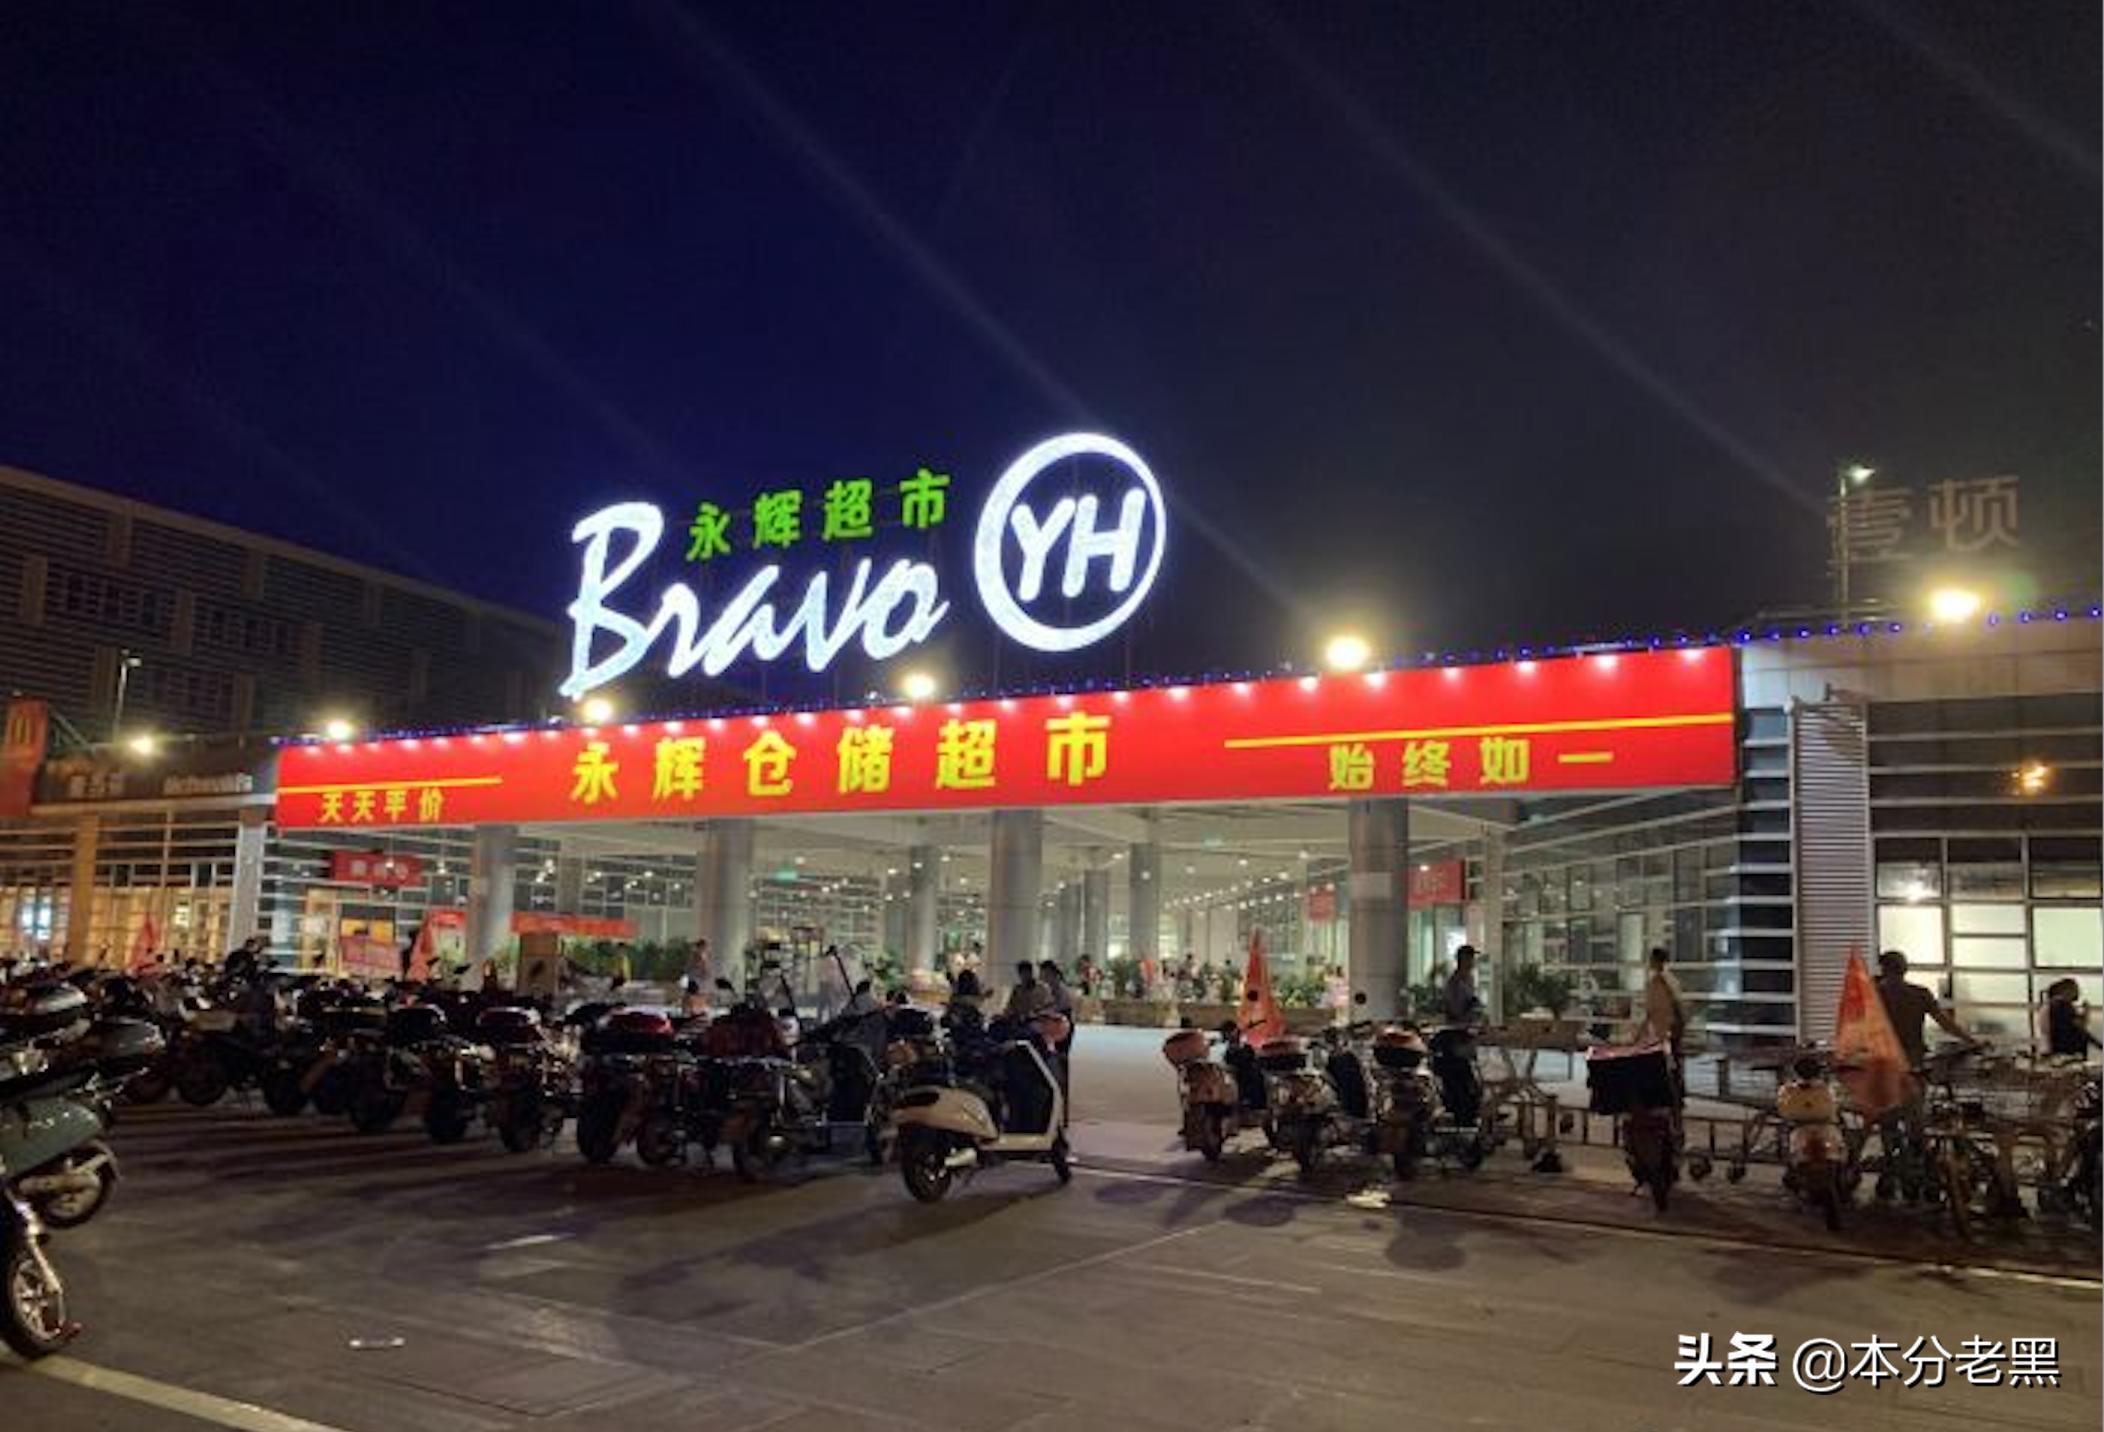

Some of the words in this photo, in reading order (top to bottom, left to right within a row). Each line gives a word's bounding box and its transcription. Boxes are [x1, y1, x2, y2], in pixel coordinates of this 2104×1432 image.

[687, 468, 951, 560] 永辉超市
[1009, 486, 1147, 602] YH
[558, 500, 951, 700] Bravo
[571, 711, 1112, 806] 永辉仓储超市
[1328, 735, 1614, 791] 始终如一
[318, 788, 444, 824] 天天平价
